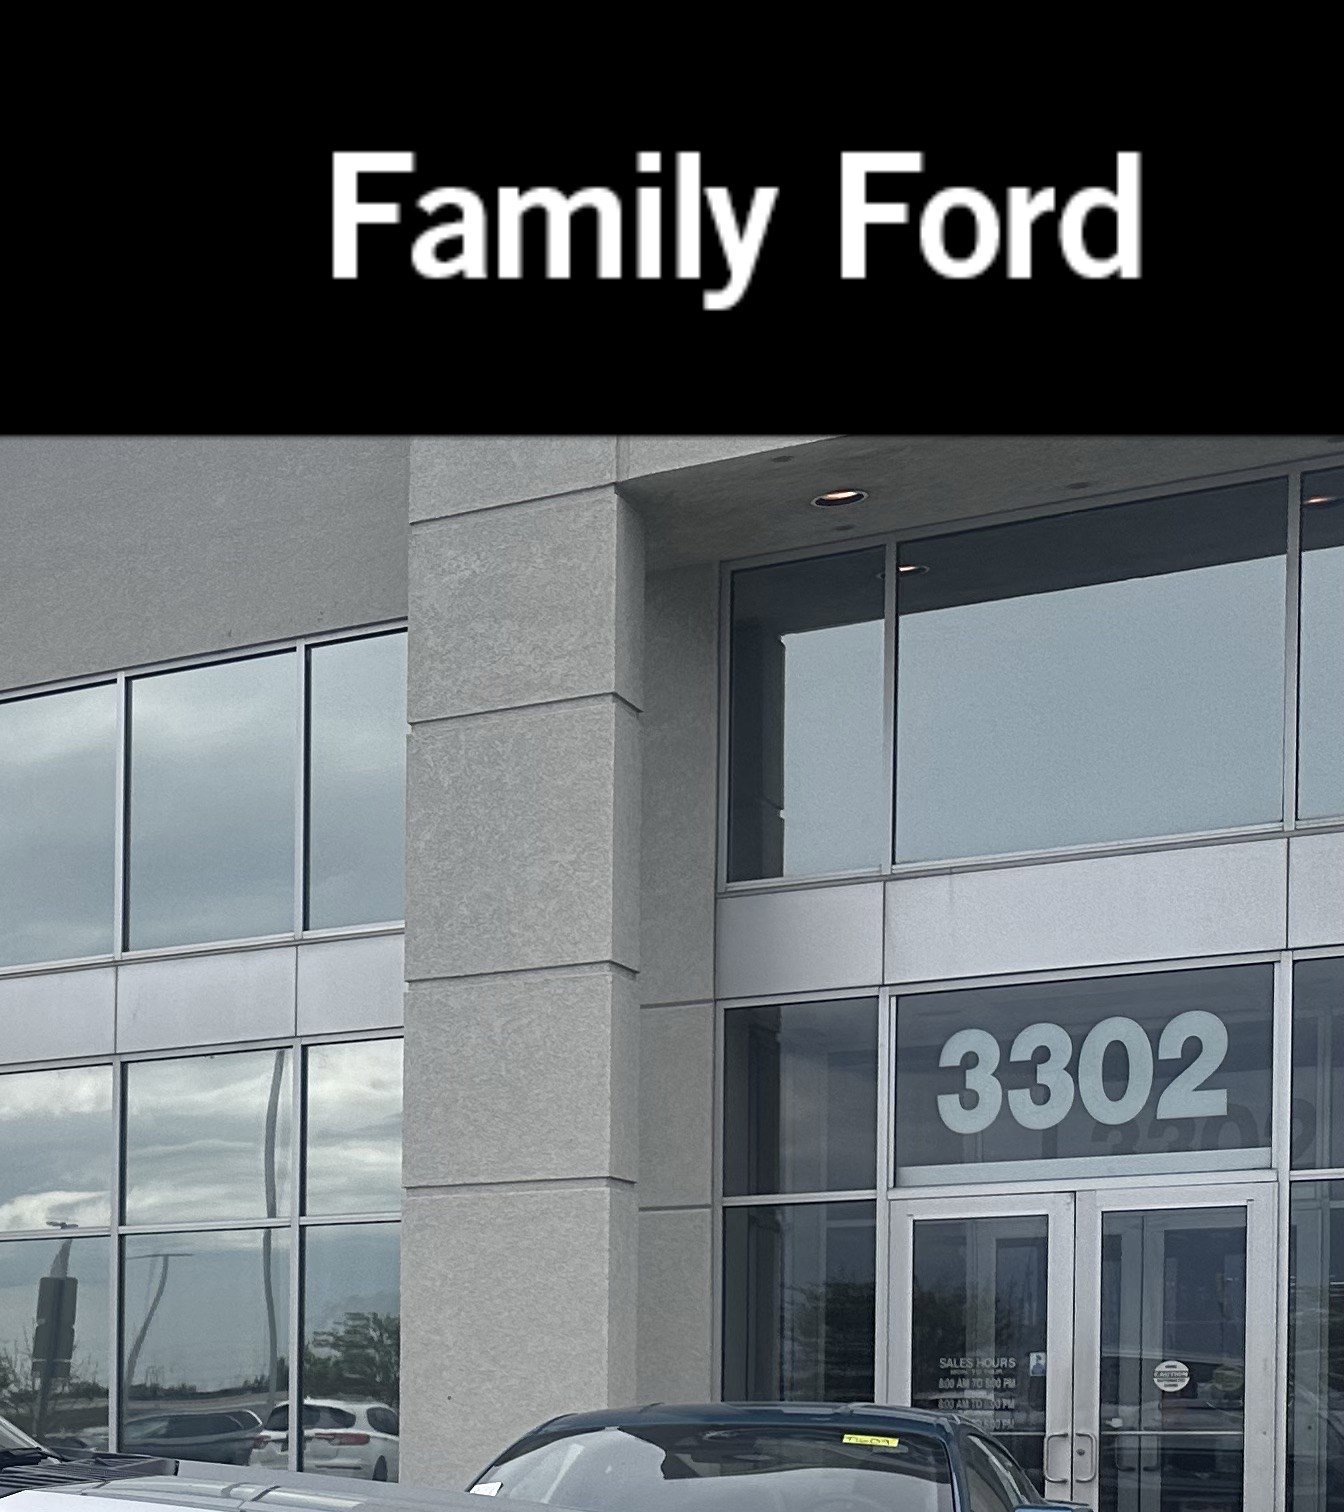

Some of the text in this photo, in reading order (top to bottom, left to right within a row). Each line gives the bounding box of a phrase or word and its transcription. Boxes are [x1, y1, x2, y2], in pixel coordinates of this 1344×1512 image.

[937, 1010, 1228, 1134] 3302
[939, 1358, 1016, 1369] SALES HOURS
[956, 1378, 970, 1389] AM
